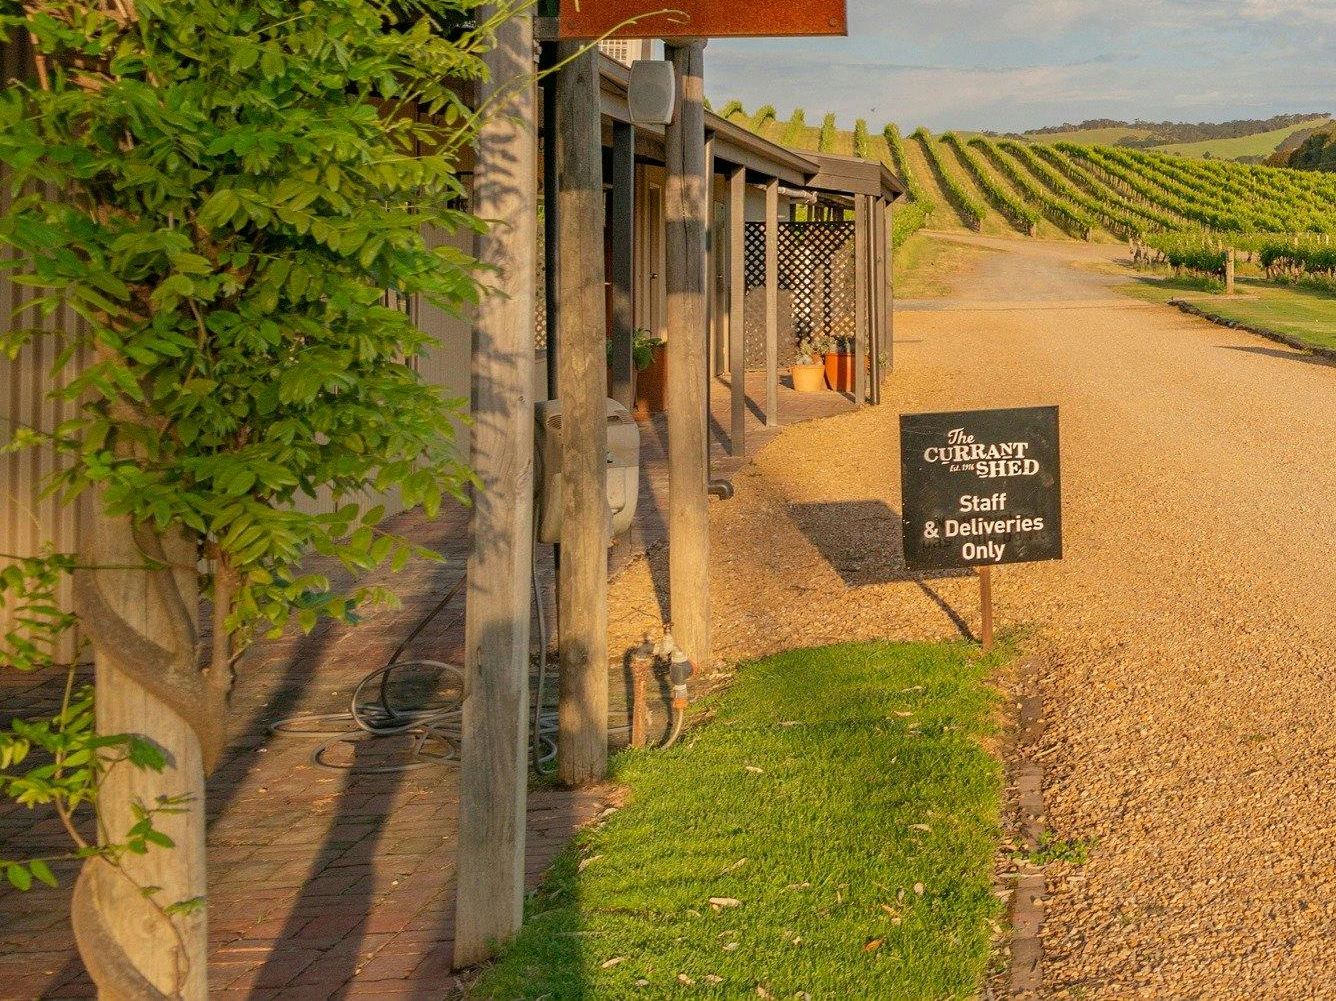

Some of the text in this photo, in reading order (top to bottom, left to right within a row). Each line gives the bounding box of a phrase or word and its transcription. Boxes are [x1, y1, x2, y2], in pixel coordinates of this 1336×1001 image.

[948, 427, 976, 445] The
[924, 442, 1029, 464] CURRANT
[976, 459, 1040, 478] SHED
[959, 493, 1007, 513] Staff
[924, 515, 1045, 539] & Deliveries
[962, 541, 1006, 562] Only
